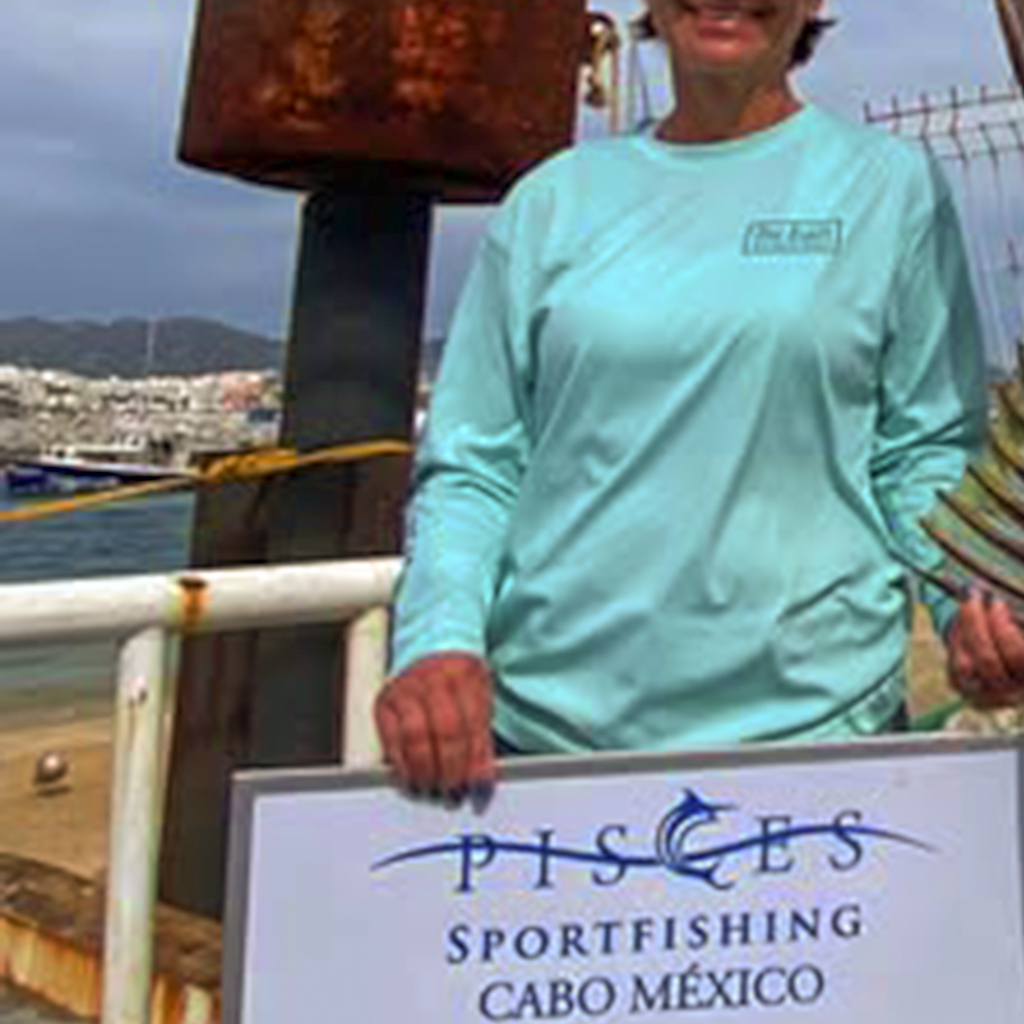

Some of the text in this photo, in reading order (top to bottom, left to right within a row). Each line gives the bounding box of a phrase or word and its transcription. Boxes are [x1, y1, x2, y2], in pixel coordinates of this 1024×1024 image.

[454, 789, 864, 894] PISCES
[446, 903, 863, 965] SPORTFISHING
[478, 962, 826, 1022] CABO MÉXICO
